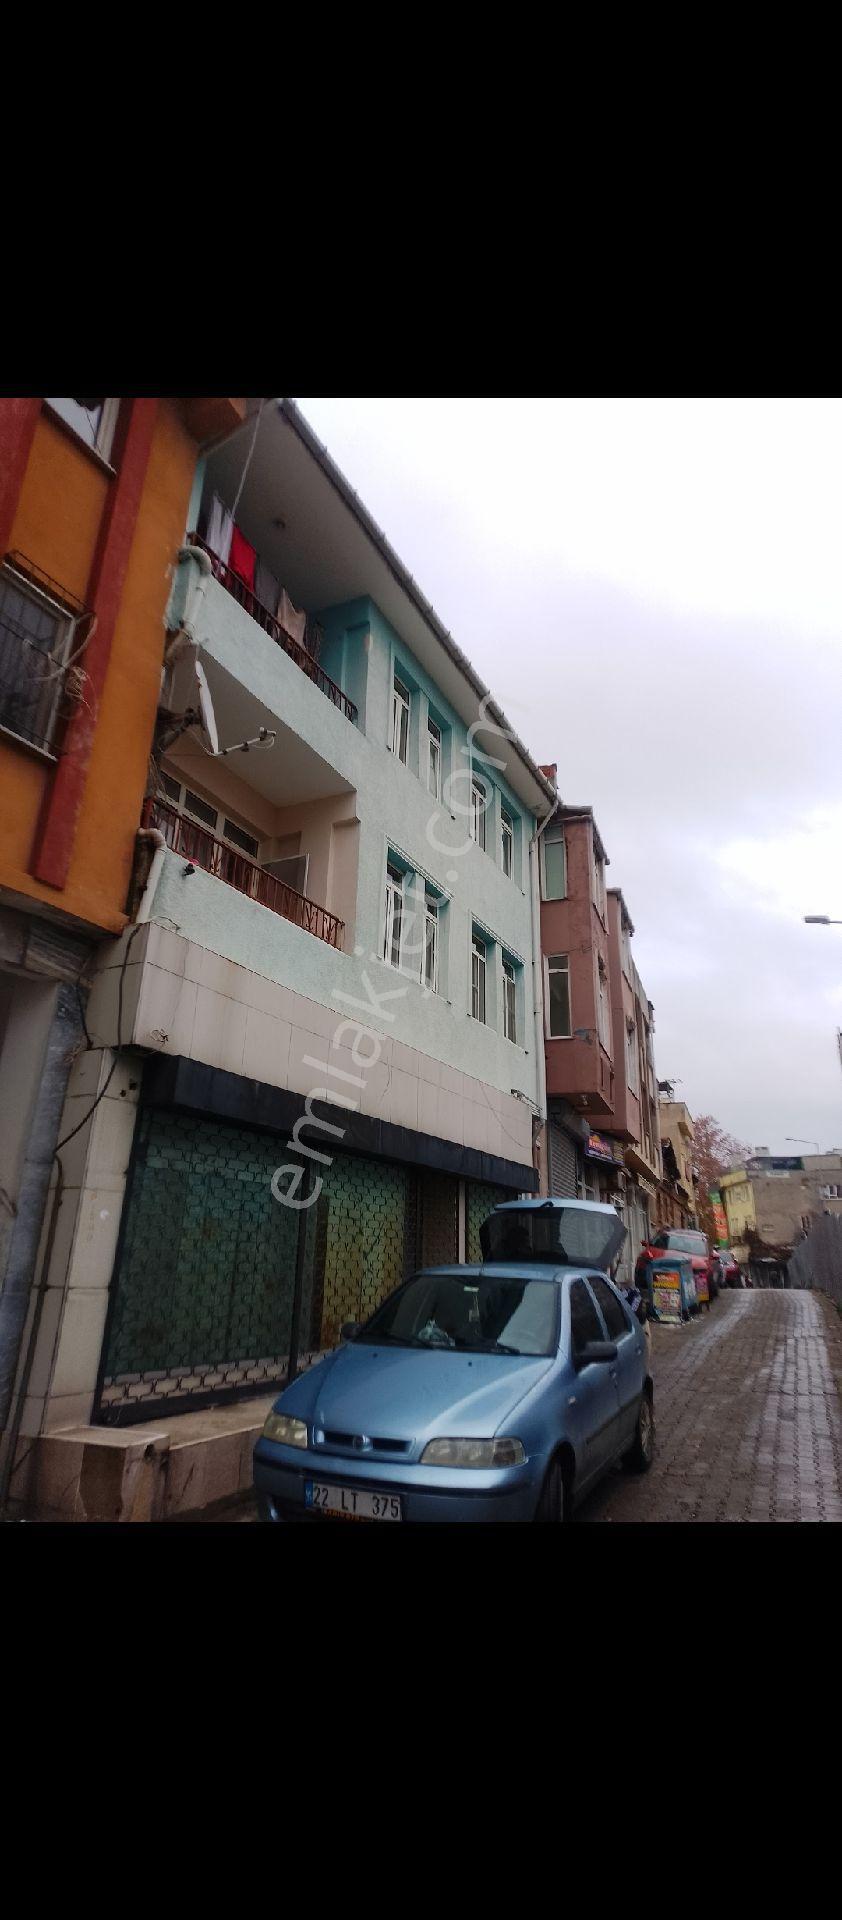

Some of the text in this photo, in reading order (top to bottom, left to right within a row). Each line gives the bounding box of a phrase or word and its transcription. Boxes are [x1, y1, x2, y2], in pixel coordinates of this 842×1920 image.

[314, 1486, 329, 1507] 22
[341, 1490, 358, 1512] LT
[372, 1495, 400, 1518] 375
